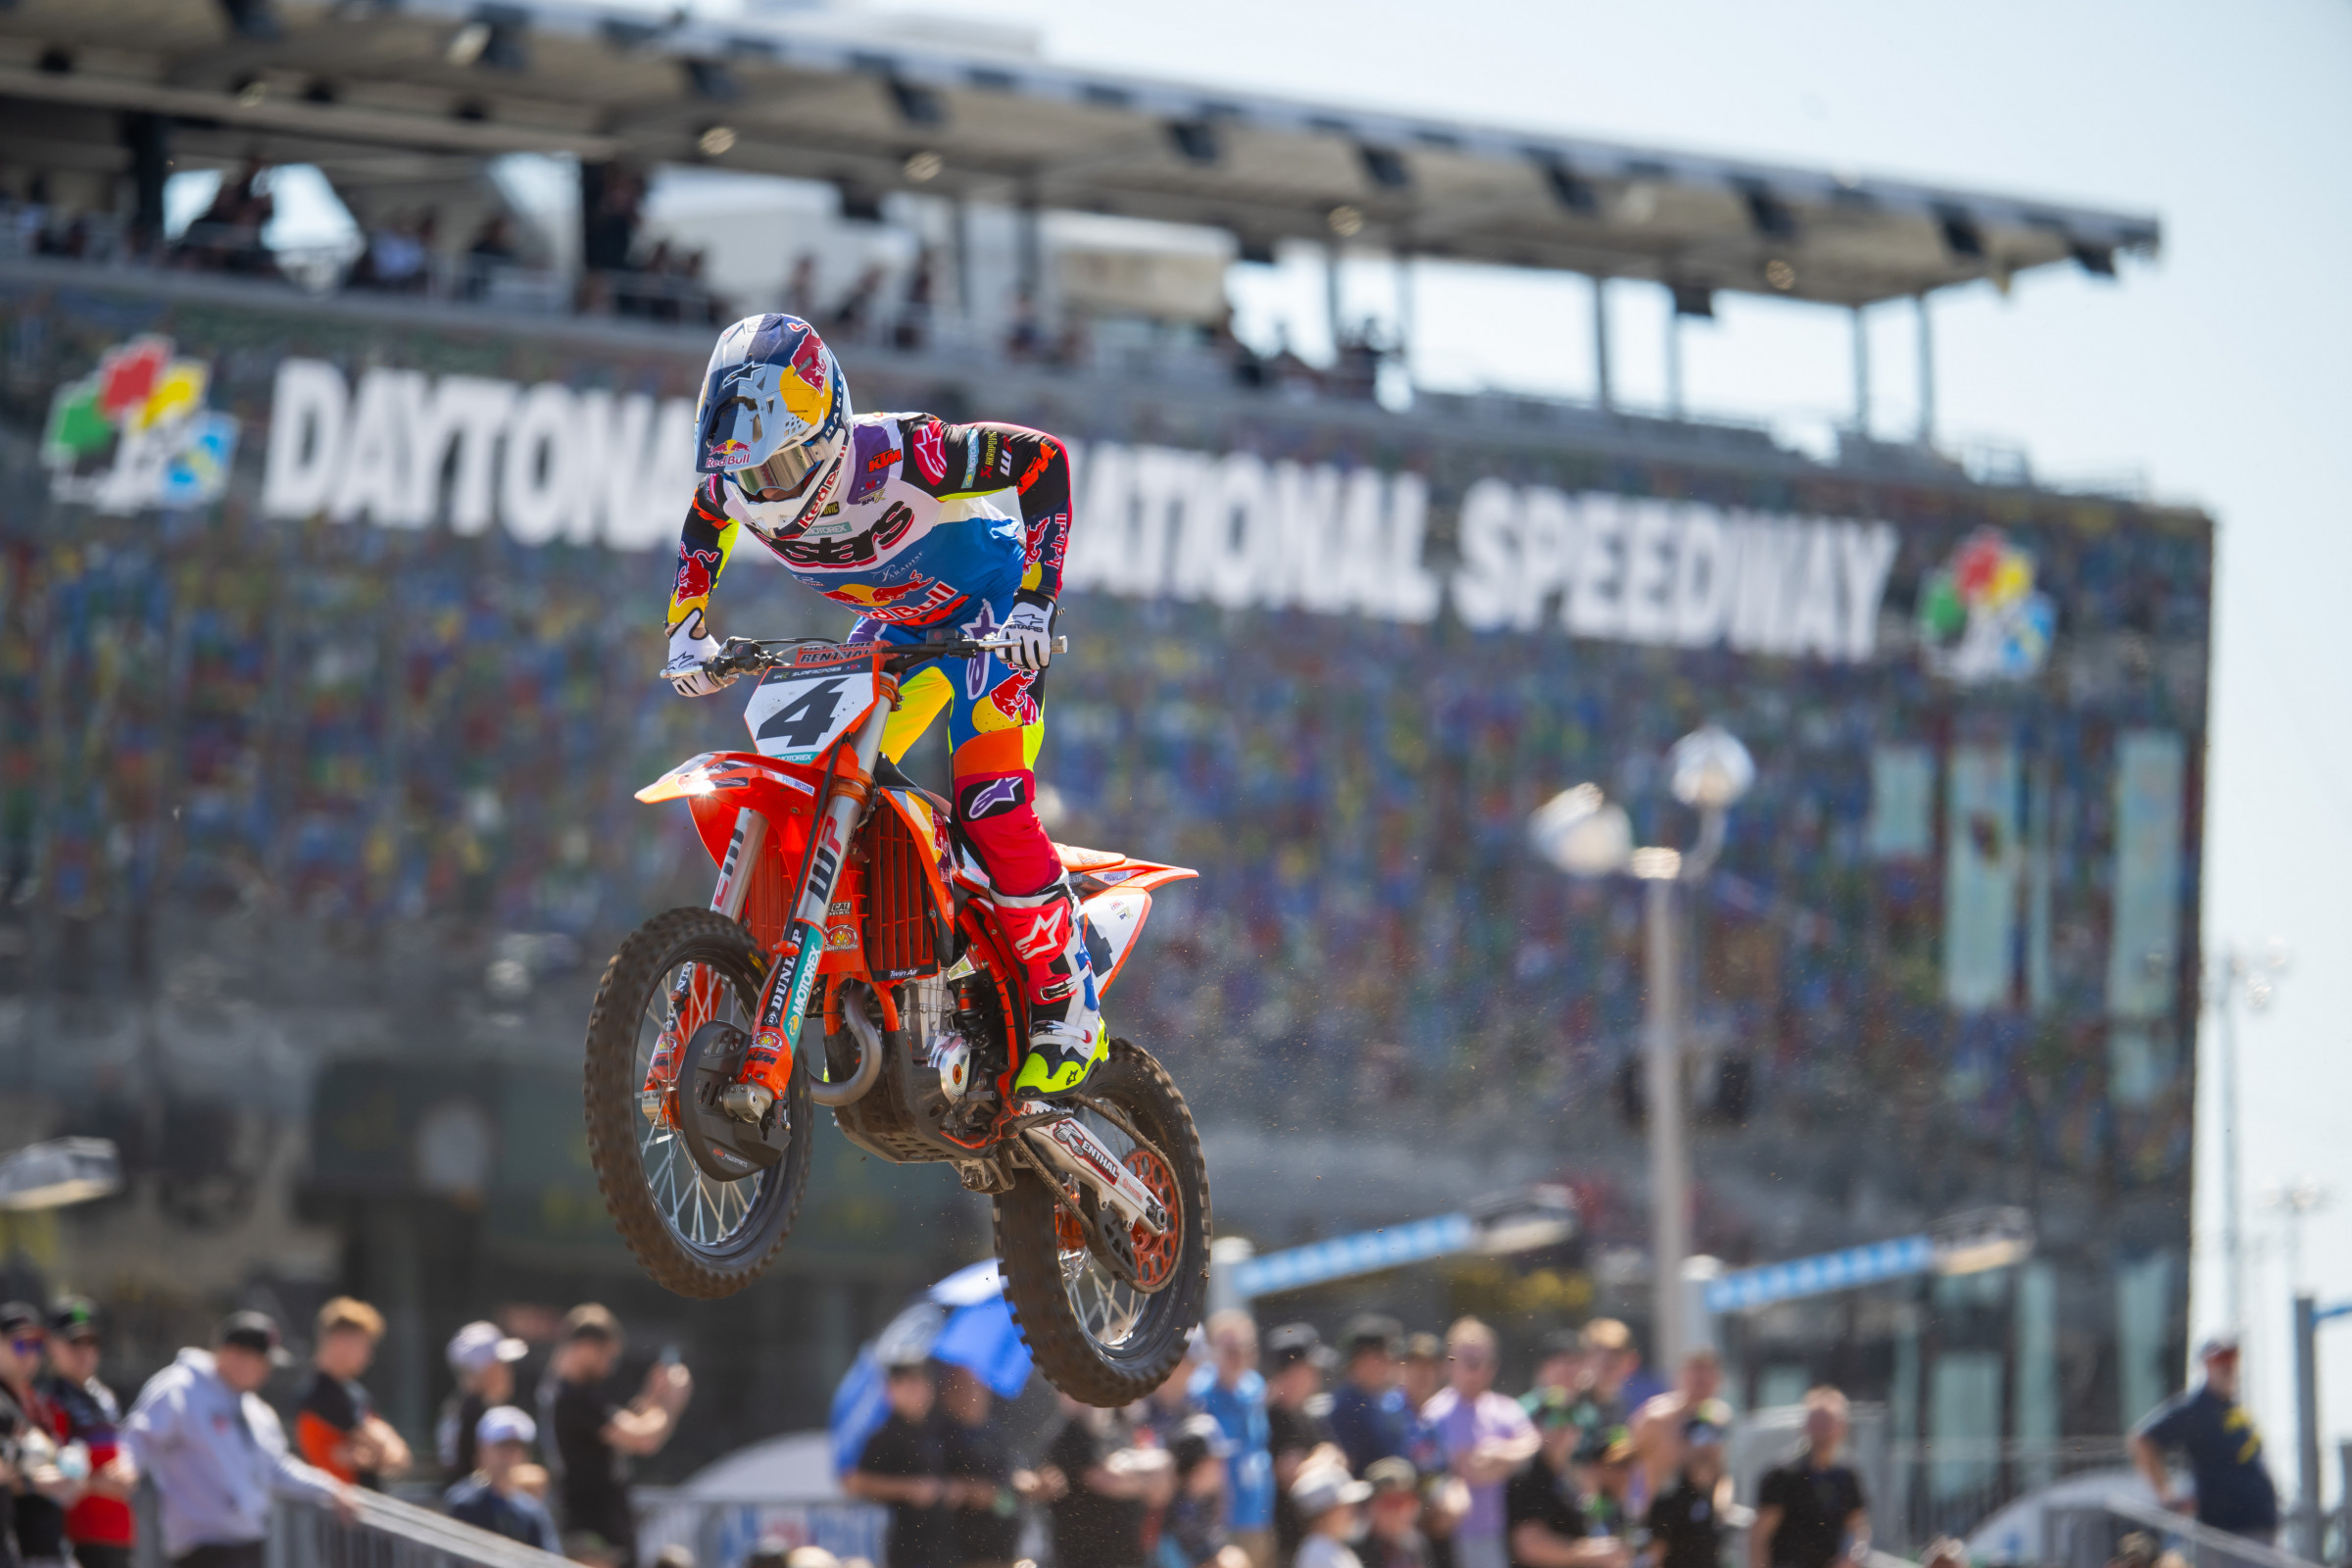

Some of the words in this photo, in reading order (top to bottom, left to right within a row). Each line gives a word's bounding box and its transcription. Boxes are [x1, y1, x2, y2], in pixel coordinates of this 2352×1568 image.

[706, 456, 727, 467] Red
[727, 454, 751, 466] Bull
[868, 448, 903, 472] KTM
[885, 580, 958, 619] Bull
[1450, 476, 1901, 663] SPEEDWAY
[755, 677, 851, 748] 4
[808, 814, 842, 906] WP
[771, 928, 804, 1011] DUNLP
[793, 943, 821, 1017] MOTOREX
[890, 969, 906, 978] Twin
[906, 967, 918, 976] Air
